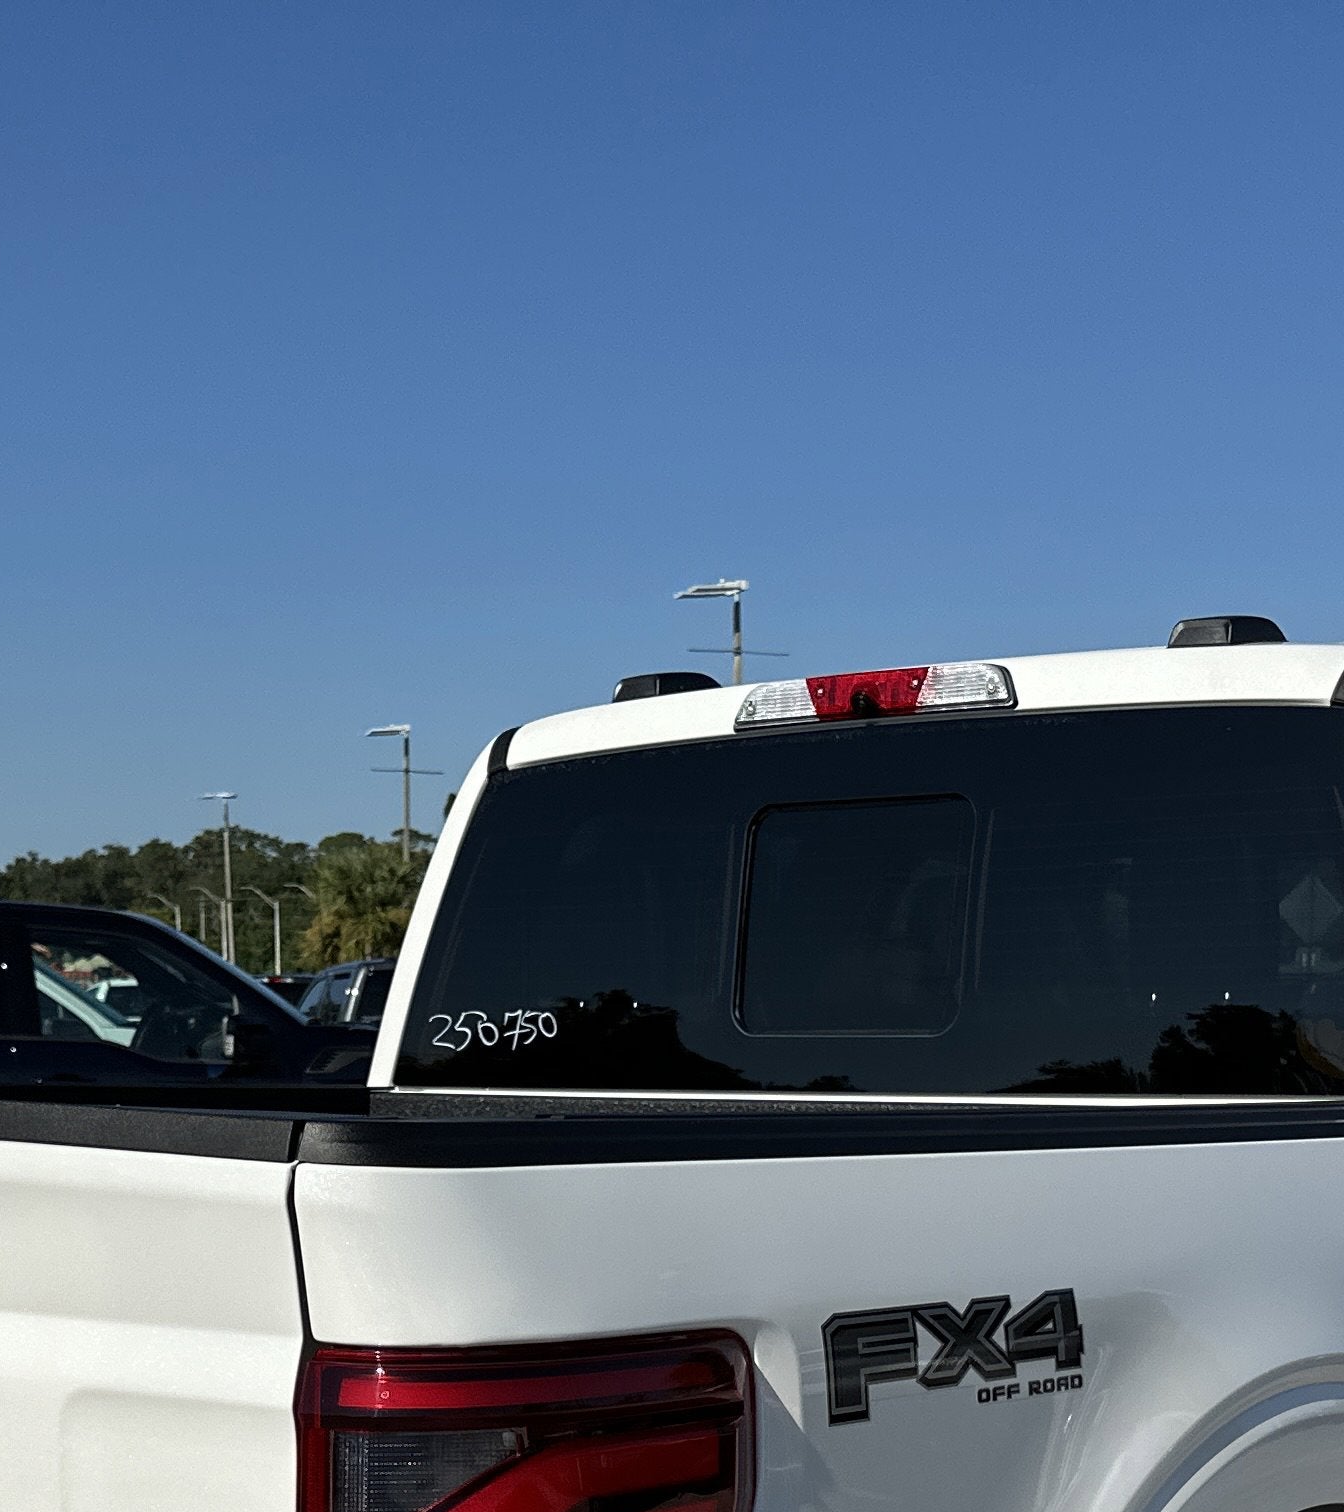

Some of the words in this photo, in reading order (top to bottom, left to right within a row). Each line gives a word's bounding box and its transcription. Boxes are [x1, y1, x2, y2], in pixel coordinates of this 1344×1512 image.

[820, 1287, 1085, 1427] FX4
[976, 1383, 1020, 1404] OFF
[1028, 1374, 1083, 1396] ROAD
